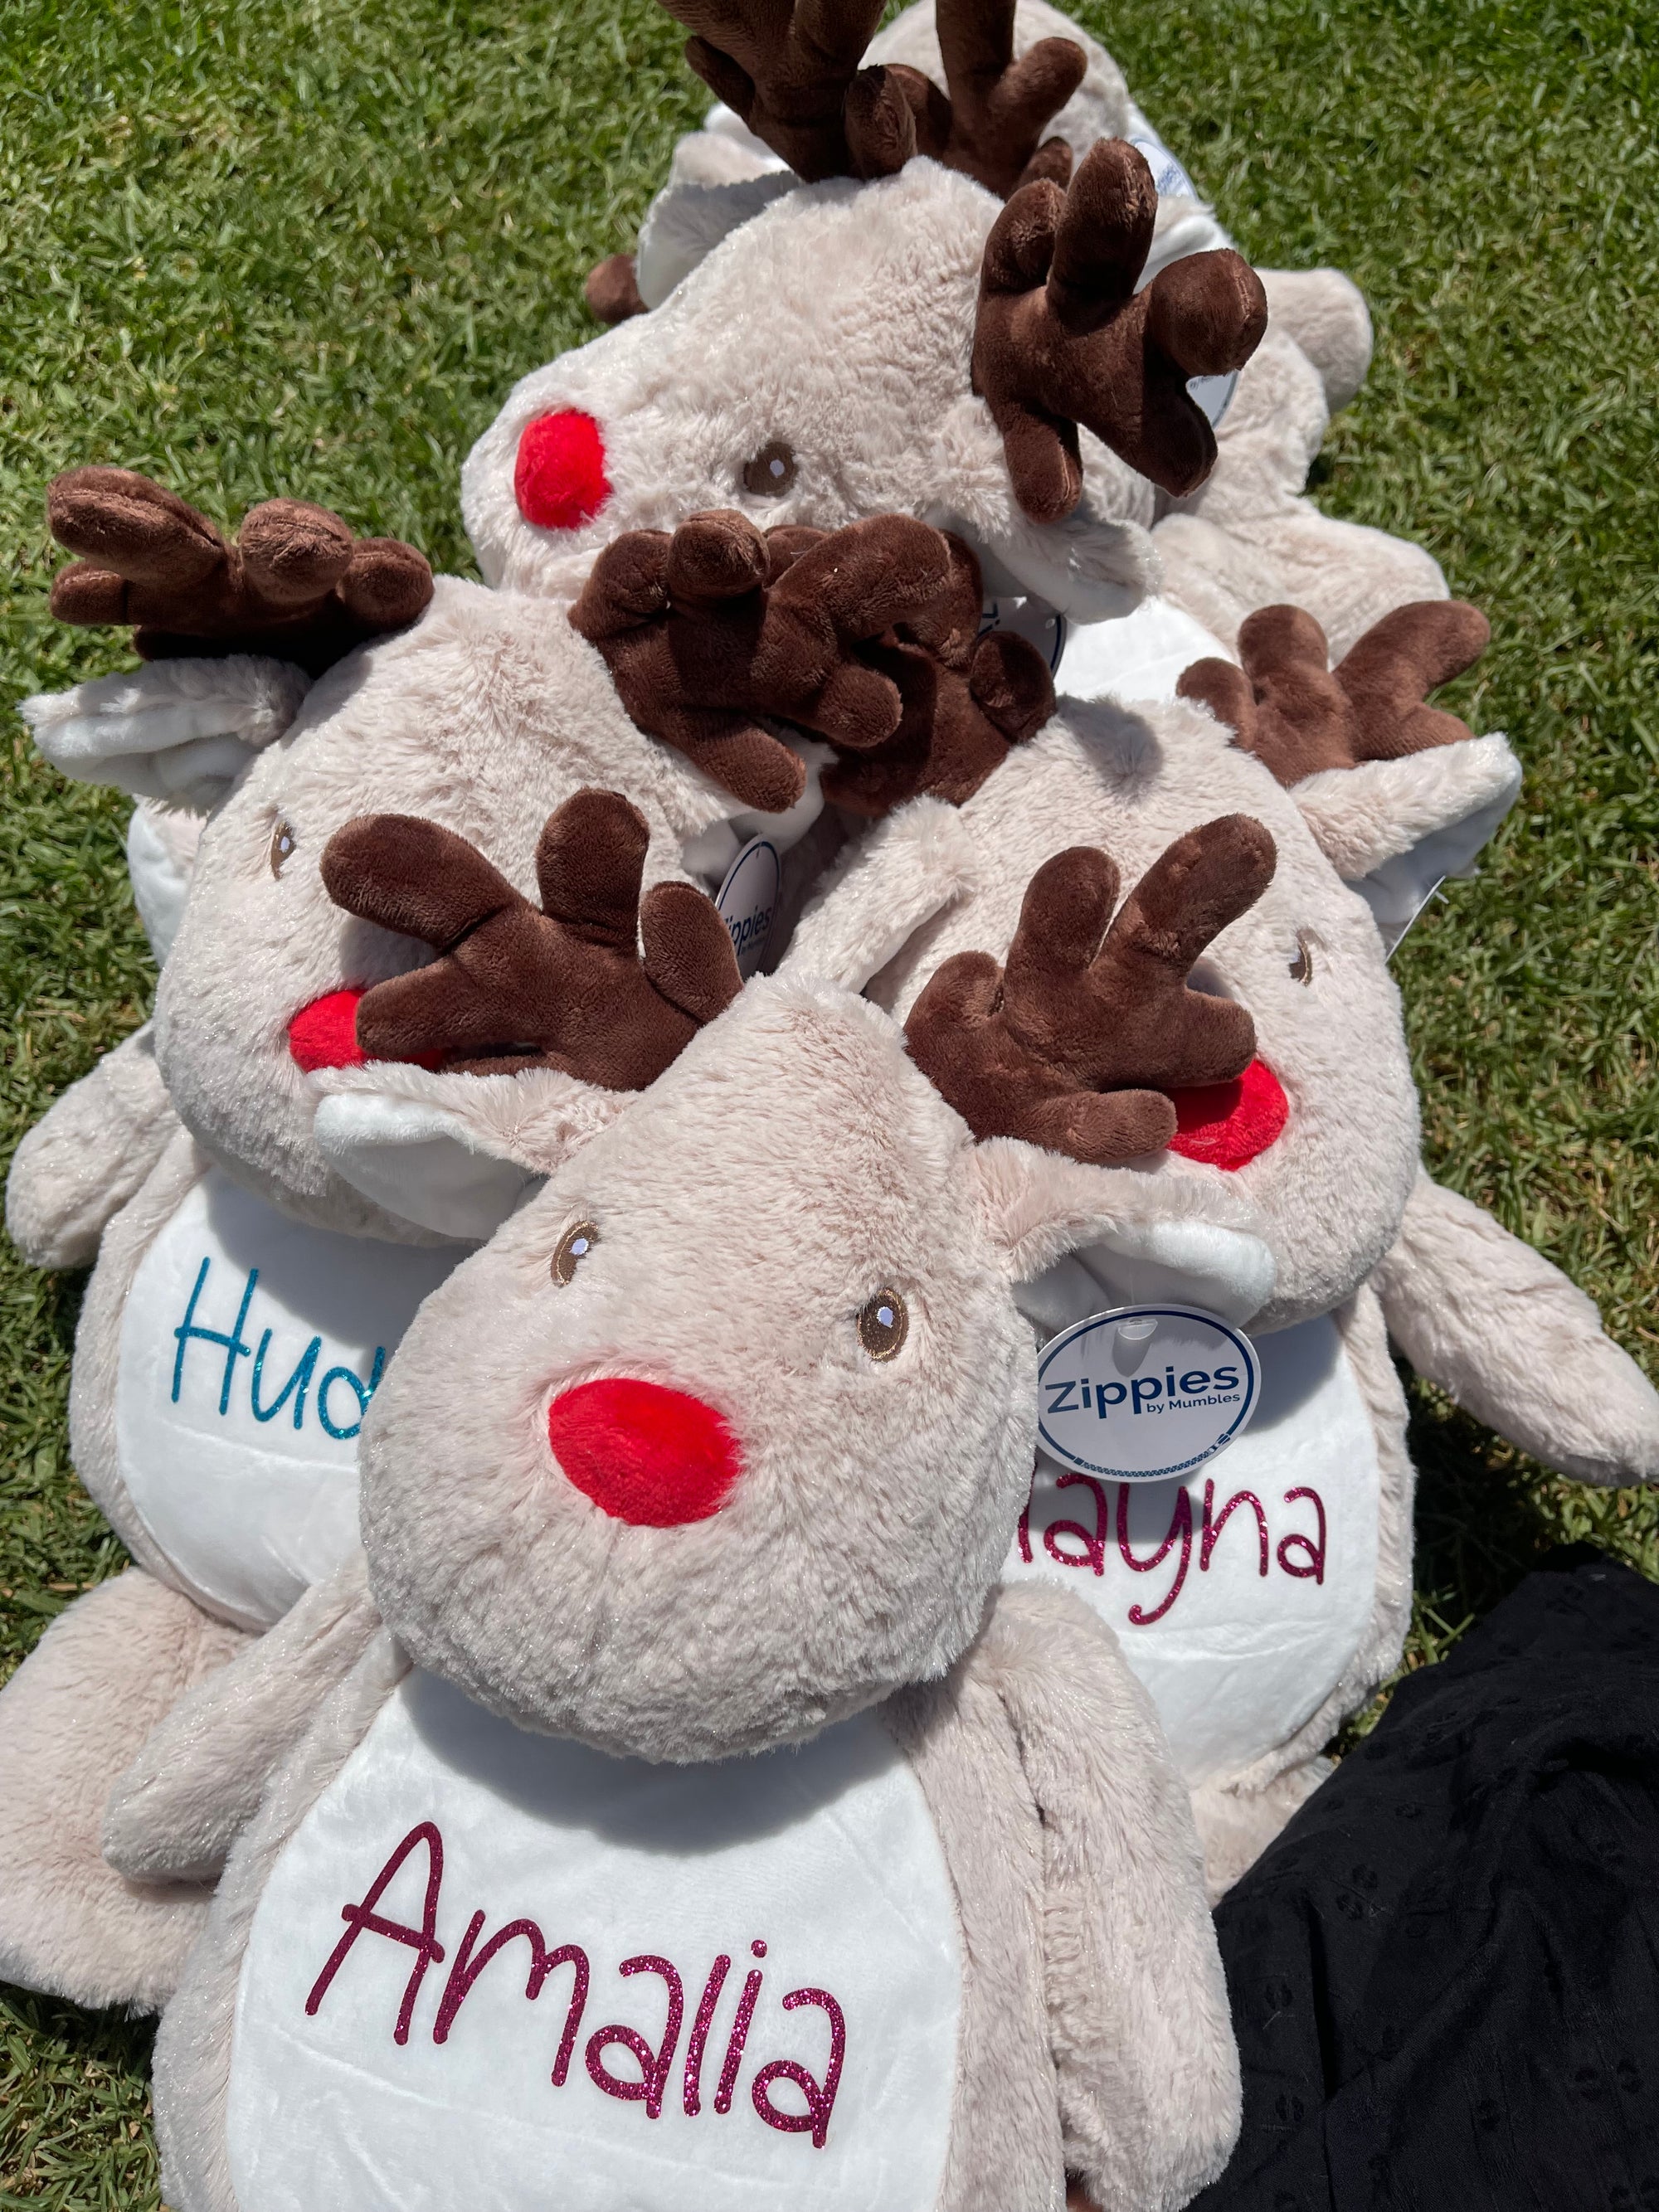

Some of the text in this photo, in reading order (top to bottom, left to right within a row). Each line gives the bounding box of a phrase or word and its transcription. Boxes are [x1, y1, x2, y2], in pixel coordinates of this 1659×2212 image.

[724, 905, 772, 956] ippies
[1044, 1365, 1240, 1420] Zippies
[1146, 1393, 1241, 1414] by Mumbles
[304, 1821, 846, 2150] Amalia
